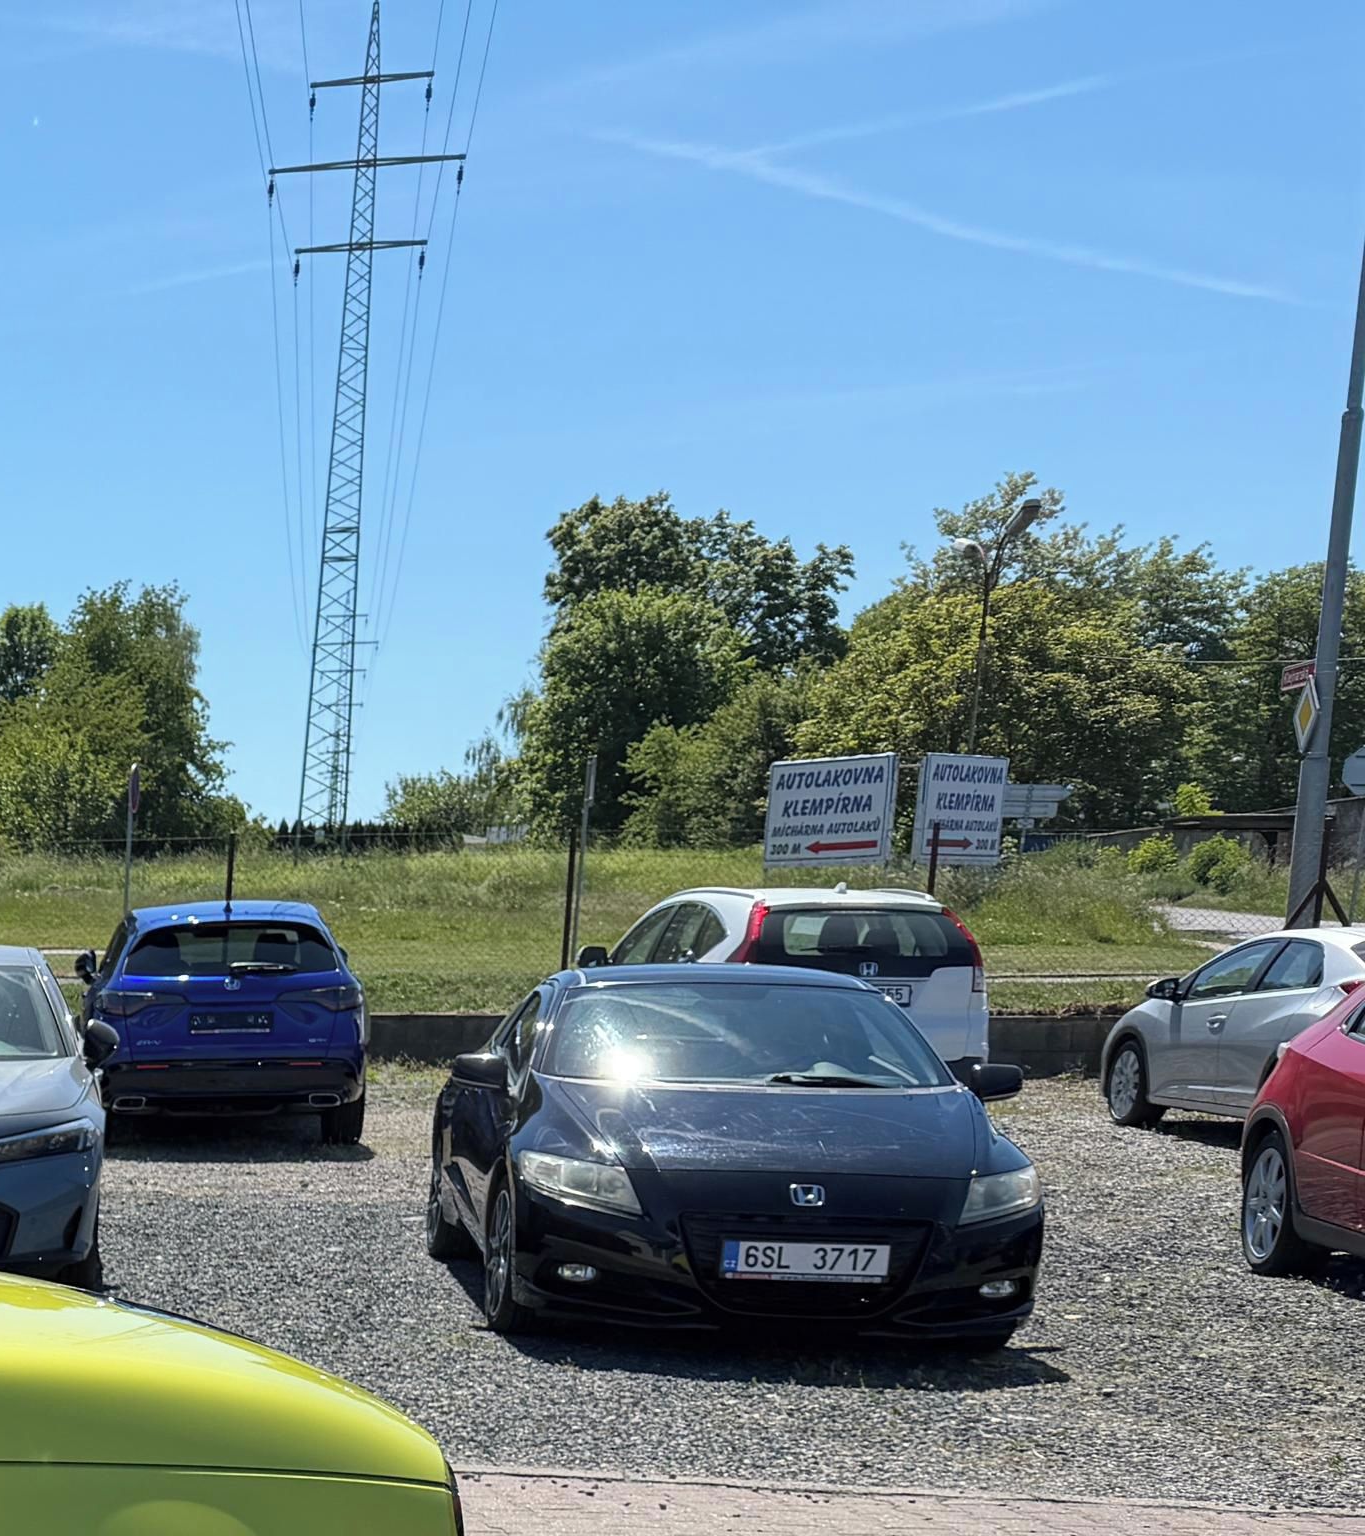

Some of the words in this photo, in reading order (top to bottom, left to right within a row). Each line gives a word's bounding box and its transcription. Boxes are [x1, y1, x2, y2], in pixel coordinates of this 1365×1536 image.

[776, 766, 884, 791] AUTOLAKOVNA
[933, 763, 1003, 785] AUTOLAKOVNA
[781, 792, 873, 818] KLEMPÍRNA
[936, 790, 995, 812] KLEMPÍRNA
[772, 822, 824, 838] MÍCHÁRNA
[827, 816, 881, 835] AUTOLAKŮ
[770, 843, 785, 855] 300
[790, 843, 801, 855] M
[724, 1260, 737, 1268] CZ
[744, 1245, 790, 1269] 6SL
[813, 1247, 877, 1271] 3717
